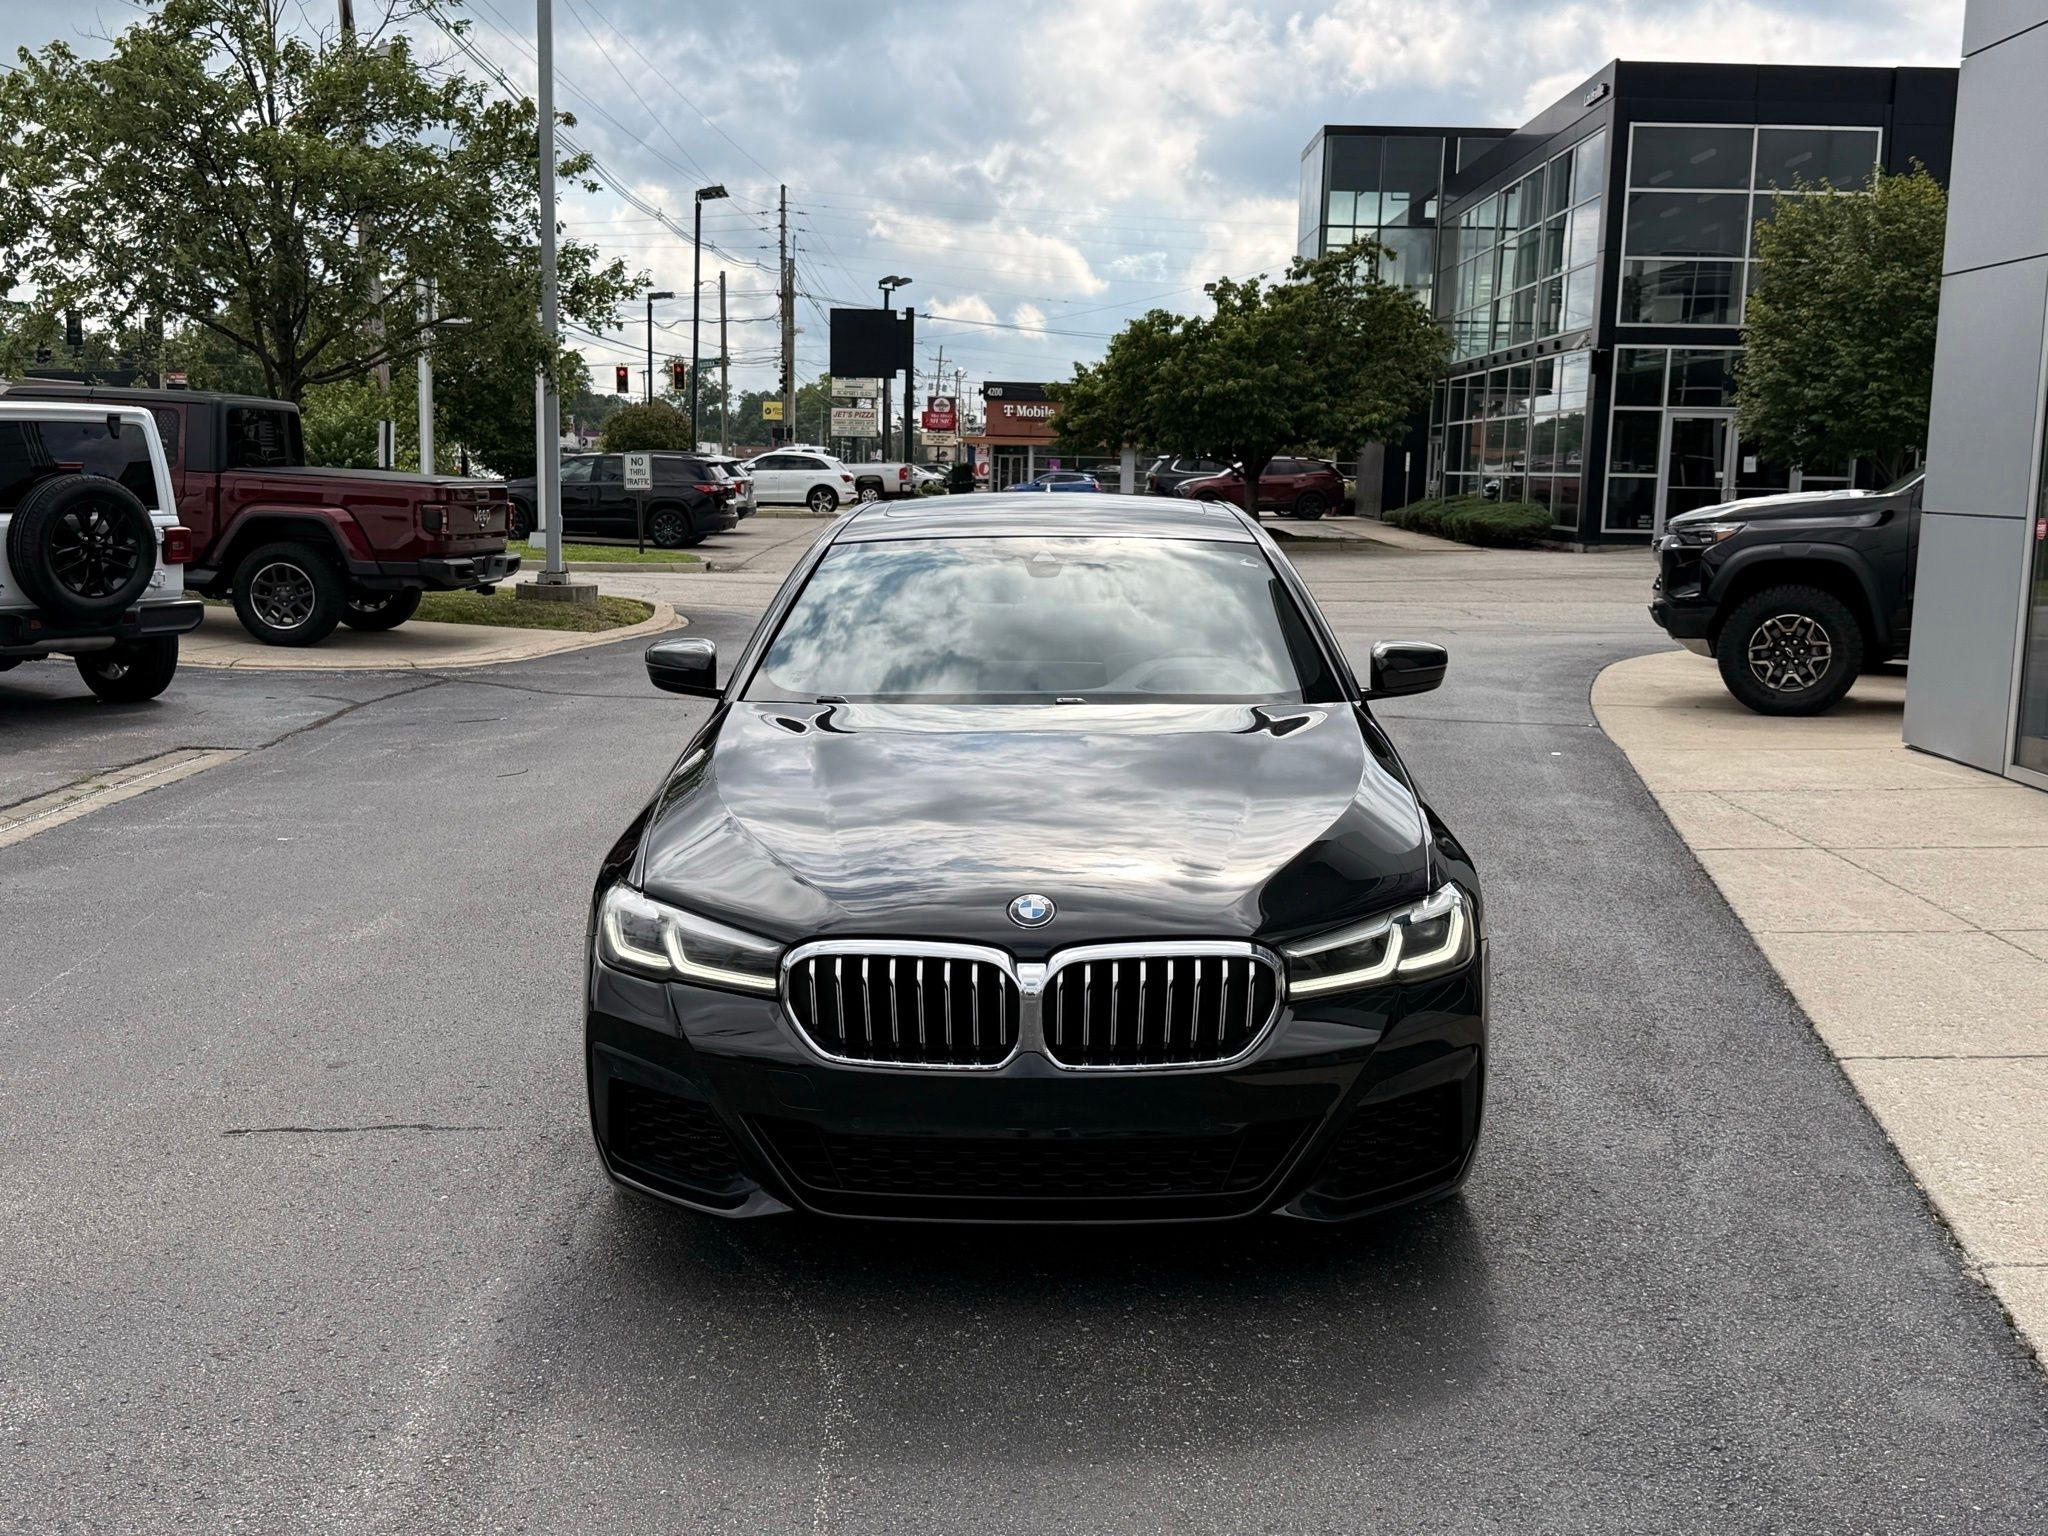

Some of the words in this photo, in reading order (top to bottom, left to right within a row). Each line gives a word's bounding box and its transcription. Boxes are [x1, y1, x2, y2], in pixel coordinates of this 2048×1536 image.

[987, 387, 1003, 396] 4200
[854, 411, 875, 419] PIZZA
[630, 457, 643, 466] NO
[626, 478, 650, 486] TRAFFIC
[473, 505, 491, 525] Jeep
